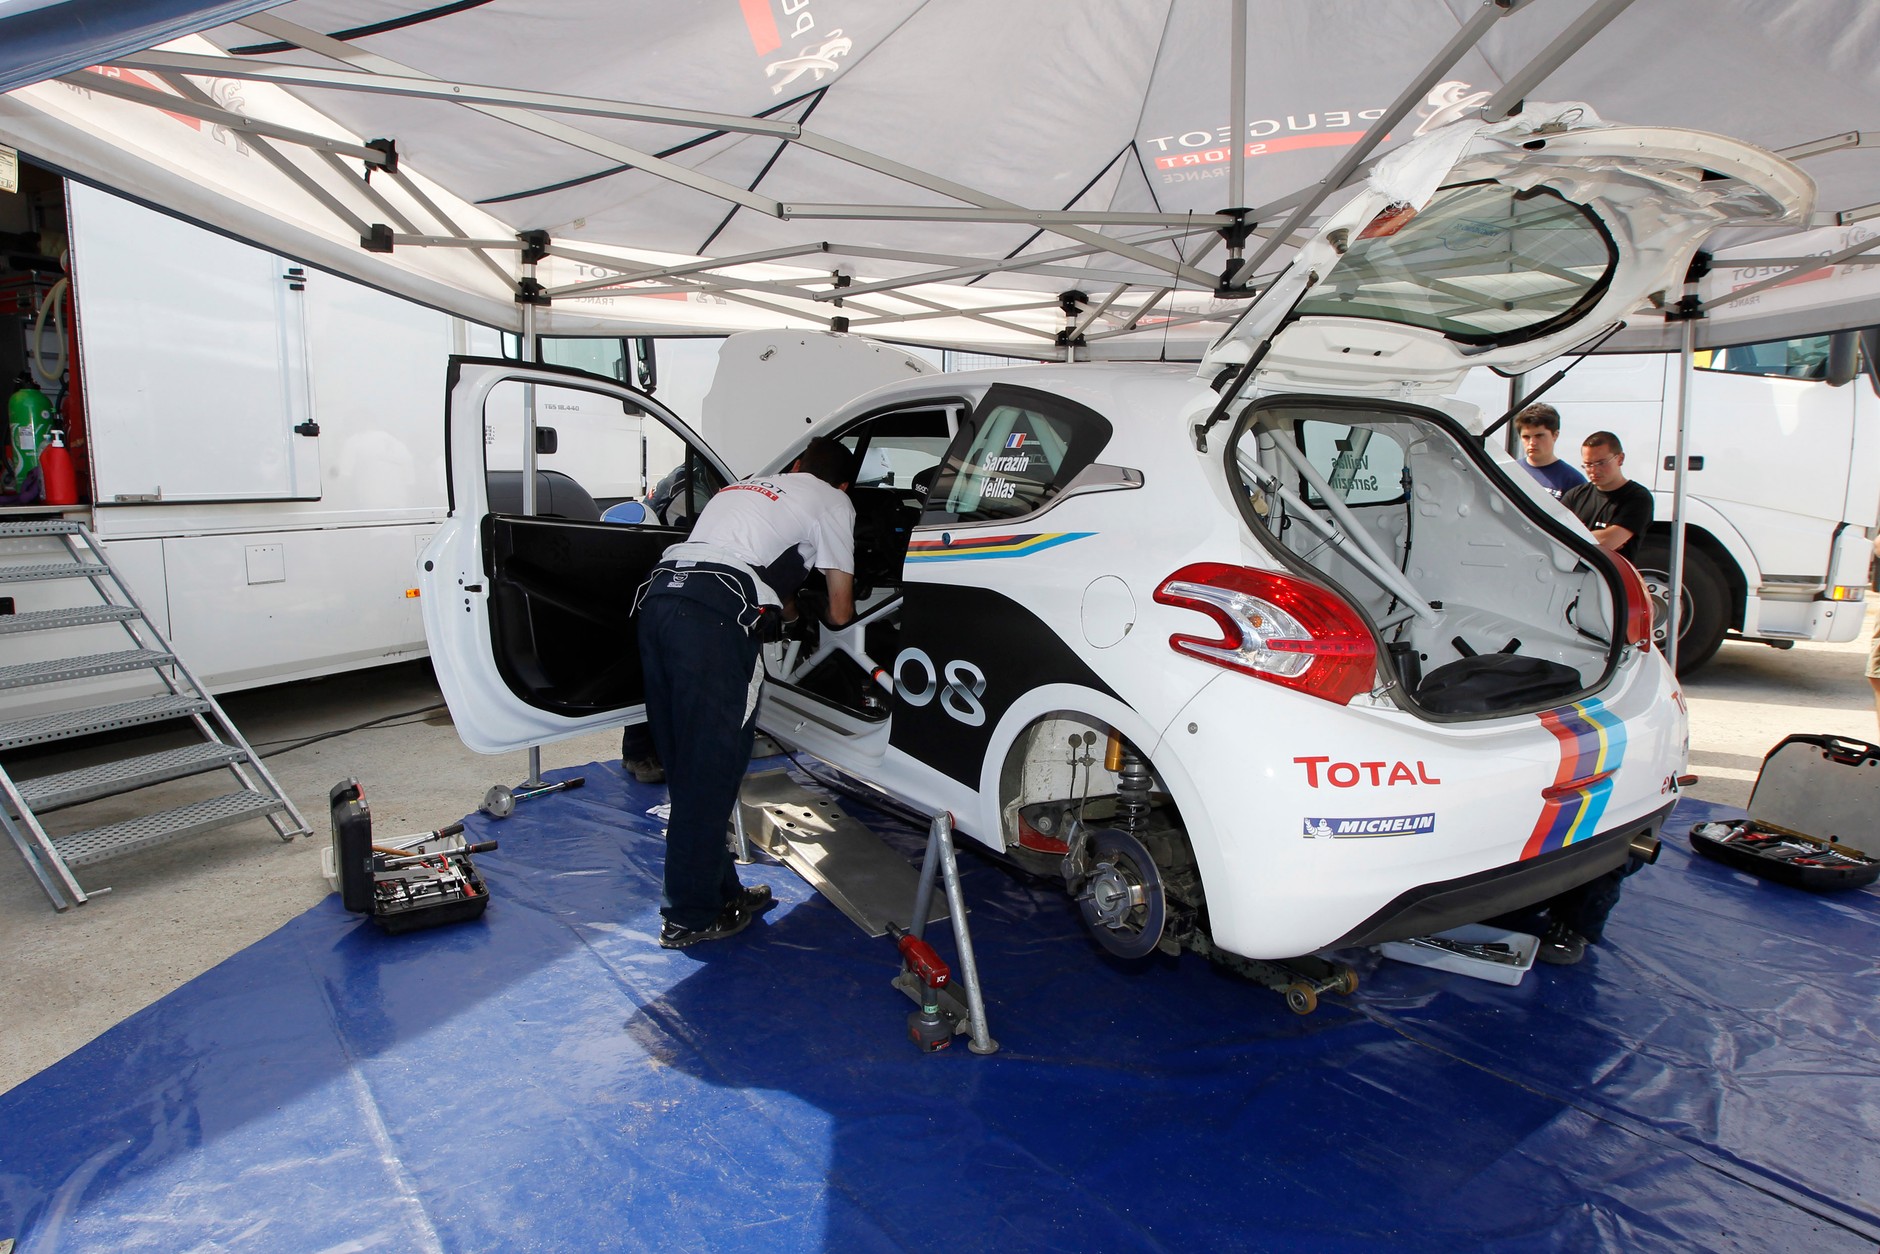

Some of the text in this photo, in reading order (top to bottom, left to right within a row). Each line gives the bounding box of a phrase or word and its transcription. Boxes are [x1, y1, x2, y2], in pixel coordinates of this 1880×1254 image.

[983, 452, 1029, 472] Sarrazin
[979, 477, 1016, 499] Veillas
[893, 647, 987, 727] 08
[1293, 756, 1441, 789] TOTAL
[1337, 815, 1434, 834] MICHELIN
